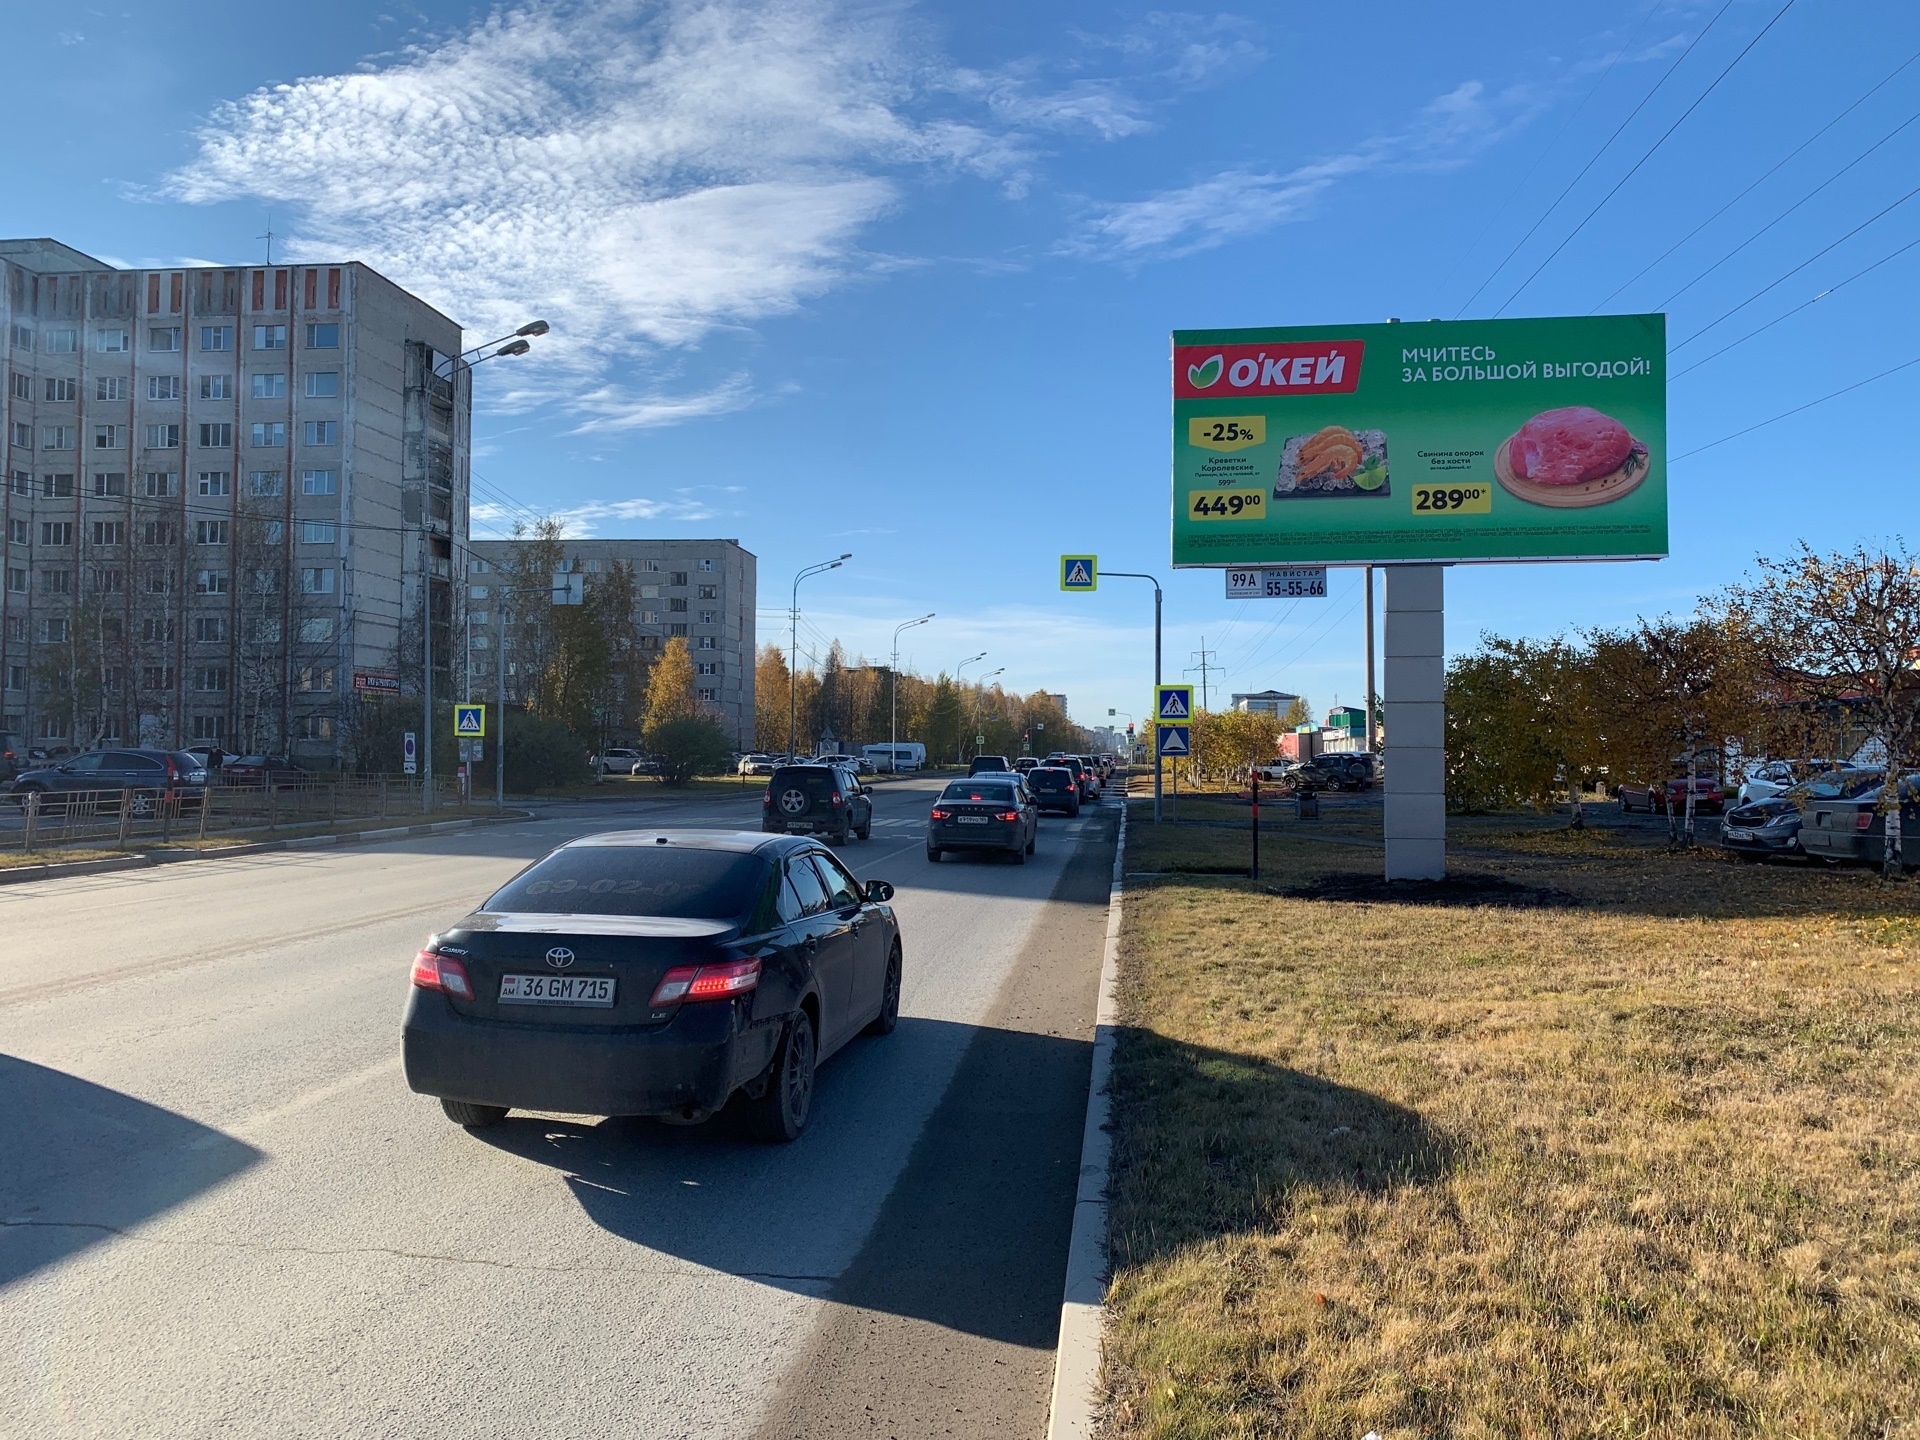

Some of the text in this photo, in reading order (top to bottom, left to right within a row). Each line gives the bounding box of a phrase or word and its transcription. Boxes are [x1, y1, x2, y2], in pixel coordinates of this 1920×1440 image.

[1402, 346, 1495, 363] МЧИТЕСЬ
[1402, 357, 1650, 382] ЗА БОЛЬШОЙ ВЫГОДОЙ!
[1203, 423, 1254, 441] -25%
[1201, 465, 1254, 473] Королевские
[1208, 457, 1247, 465] Креветки
[1266, 580, 1323, 596] 55-55-66
[523, 978, 543, 997] 36
[548, 979, 573, 998] GM
[577, 980, 609, 999] 715
